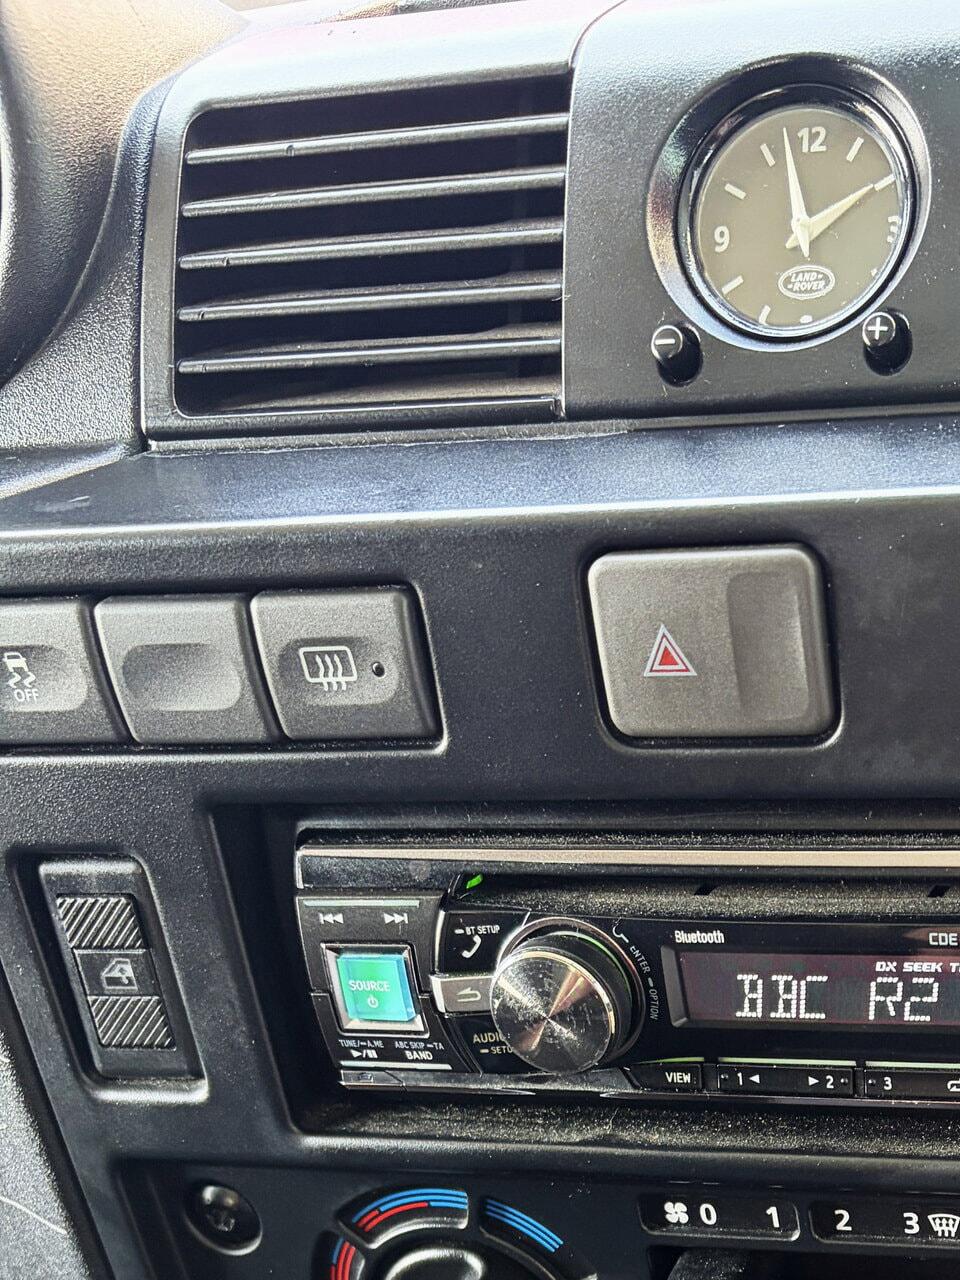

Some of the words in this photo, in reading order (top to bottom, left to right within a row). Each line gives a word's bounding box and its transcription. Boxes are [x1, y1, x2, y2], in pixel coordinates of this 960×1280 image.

[797, 126, 827, 153] 12
[714, 226, 730, 253] 9
[790, 271, 818, 283] LAND
[792, 279, 826, 292] ROVER
[13, 688, 39, 704] OFF
[465, 926, 476, 935] BT
[477, 924, 500, 935] SETUP
[674, 930, 725, 945] Bluetooth
[629, 945, 651, 974] ENTER
[902, 962, 943, 974] SEEK
[348, 980, 391, 992] SOURCE
[649, 988, 659, 1020] OPTION
[735, 973, 829, 1020] BBC
[868, 976, 940, 1022] R2
[404, 1050, 434, 1061] BAND
[490, 1045, 514, 1055] SETU
[665, 1071, 692, 1084] VIEW
[737, 1072, 743, 1086] 1
[826, 1074, 835, 1089] 2
[883, 1077, 892, 1090] 3
[699, 1203, 717, 1226] 0
[766, 1206, 780, 1229] 1
[834, 1209, 852, 1232] 2
[903, 1212, 920, 1235] 3
